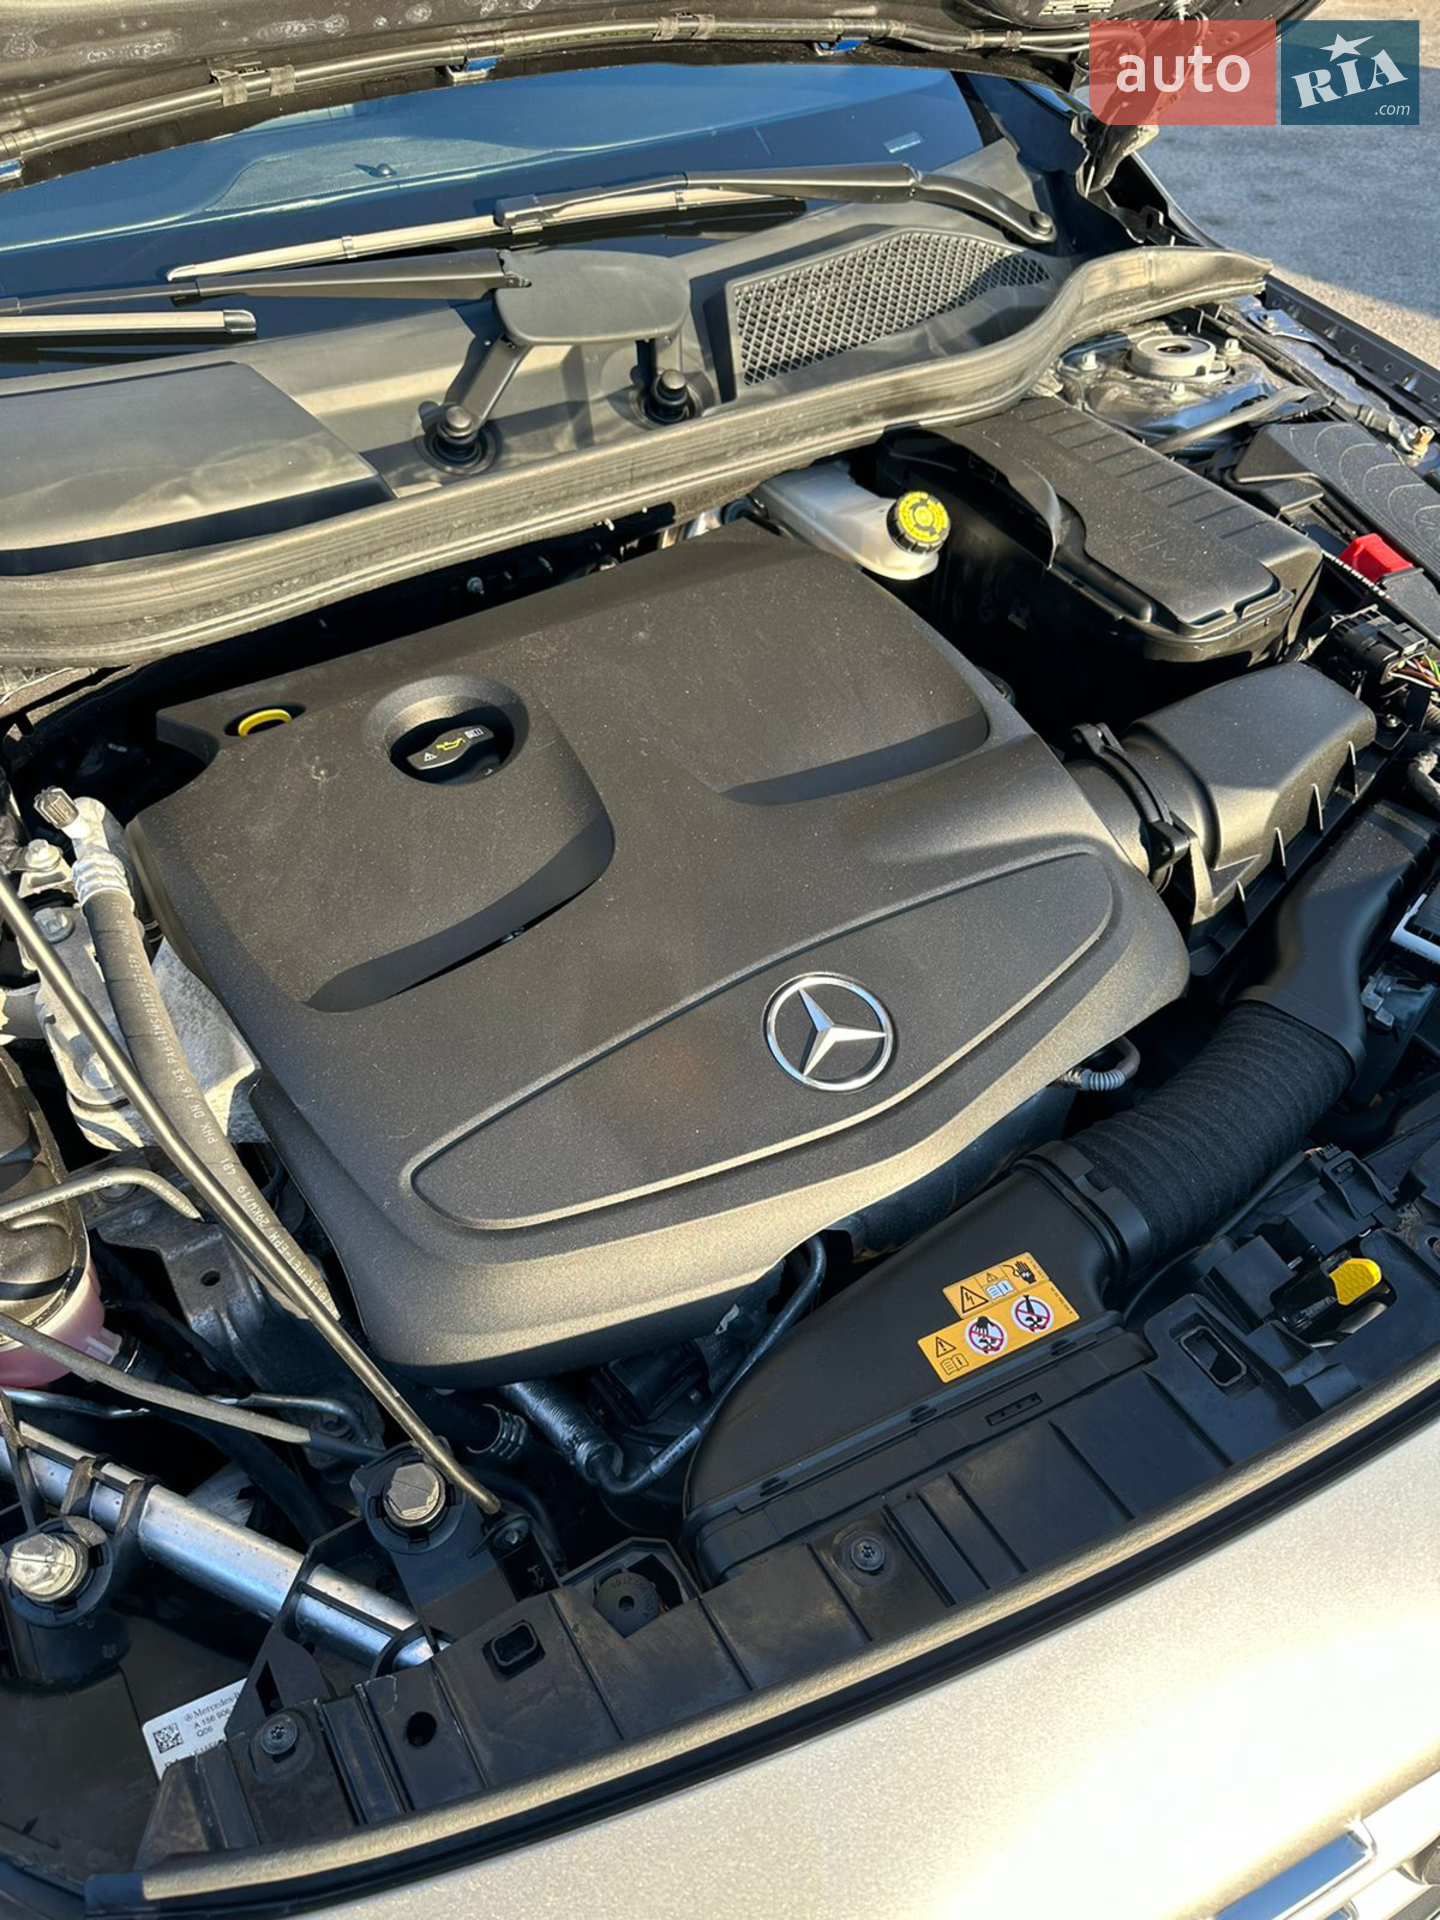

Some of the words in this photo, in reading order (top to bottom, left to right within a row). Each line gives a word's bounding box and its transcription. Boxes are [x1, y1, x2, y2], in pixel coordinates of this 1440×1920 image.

[172, 1068, 187, 1082] H3
[182, 1086, 194, 1099] 16
[189, 1104, 205, 1119] DN
[200, 1121, 218, 1144] PHX
[193, 1722, 201, 1730] A
[202, 1714, 216, 1727] 156
[196, 1725, 214, 1737] Q06
